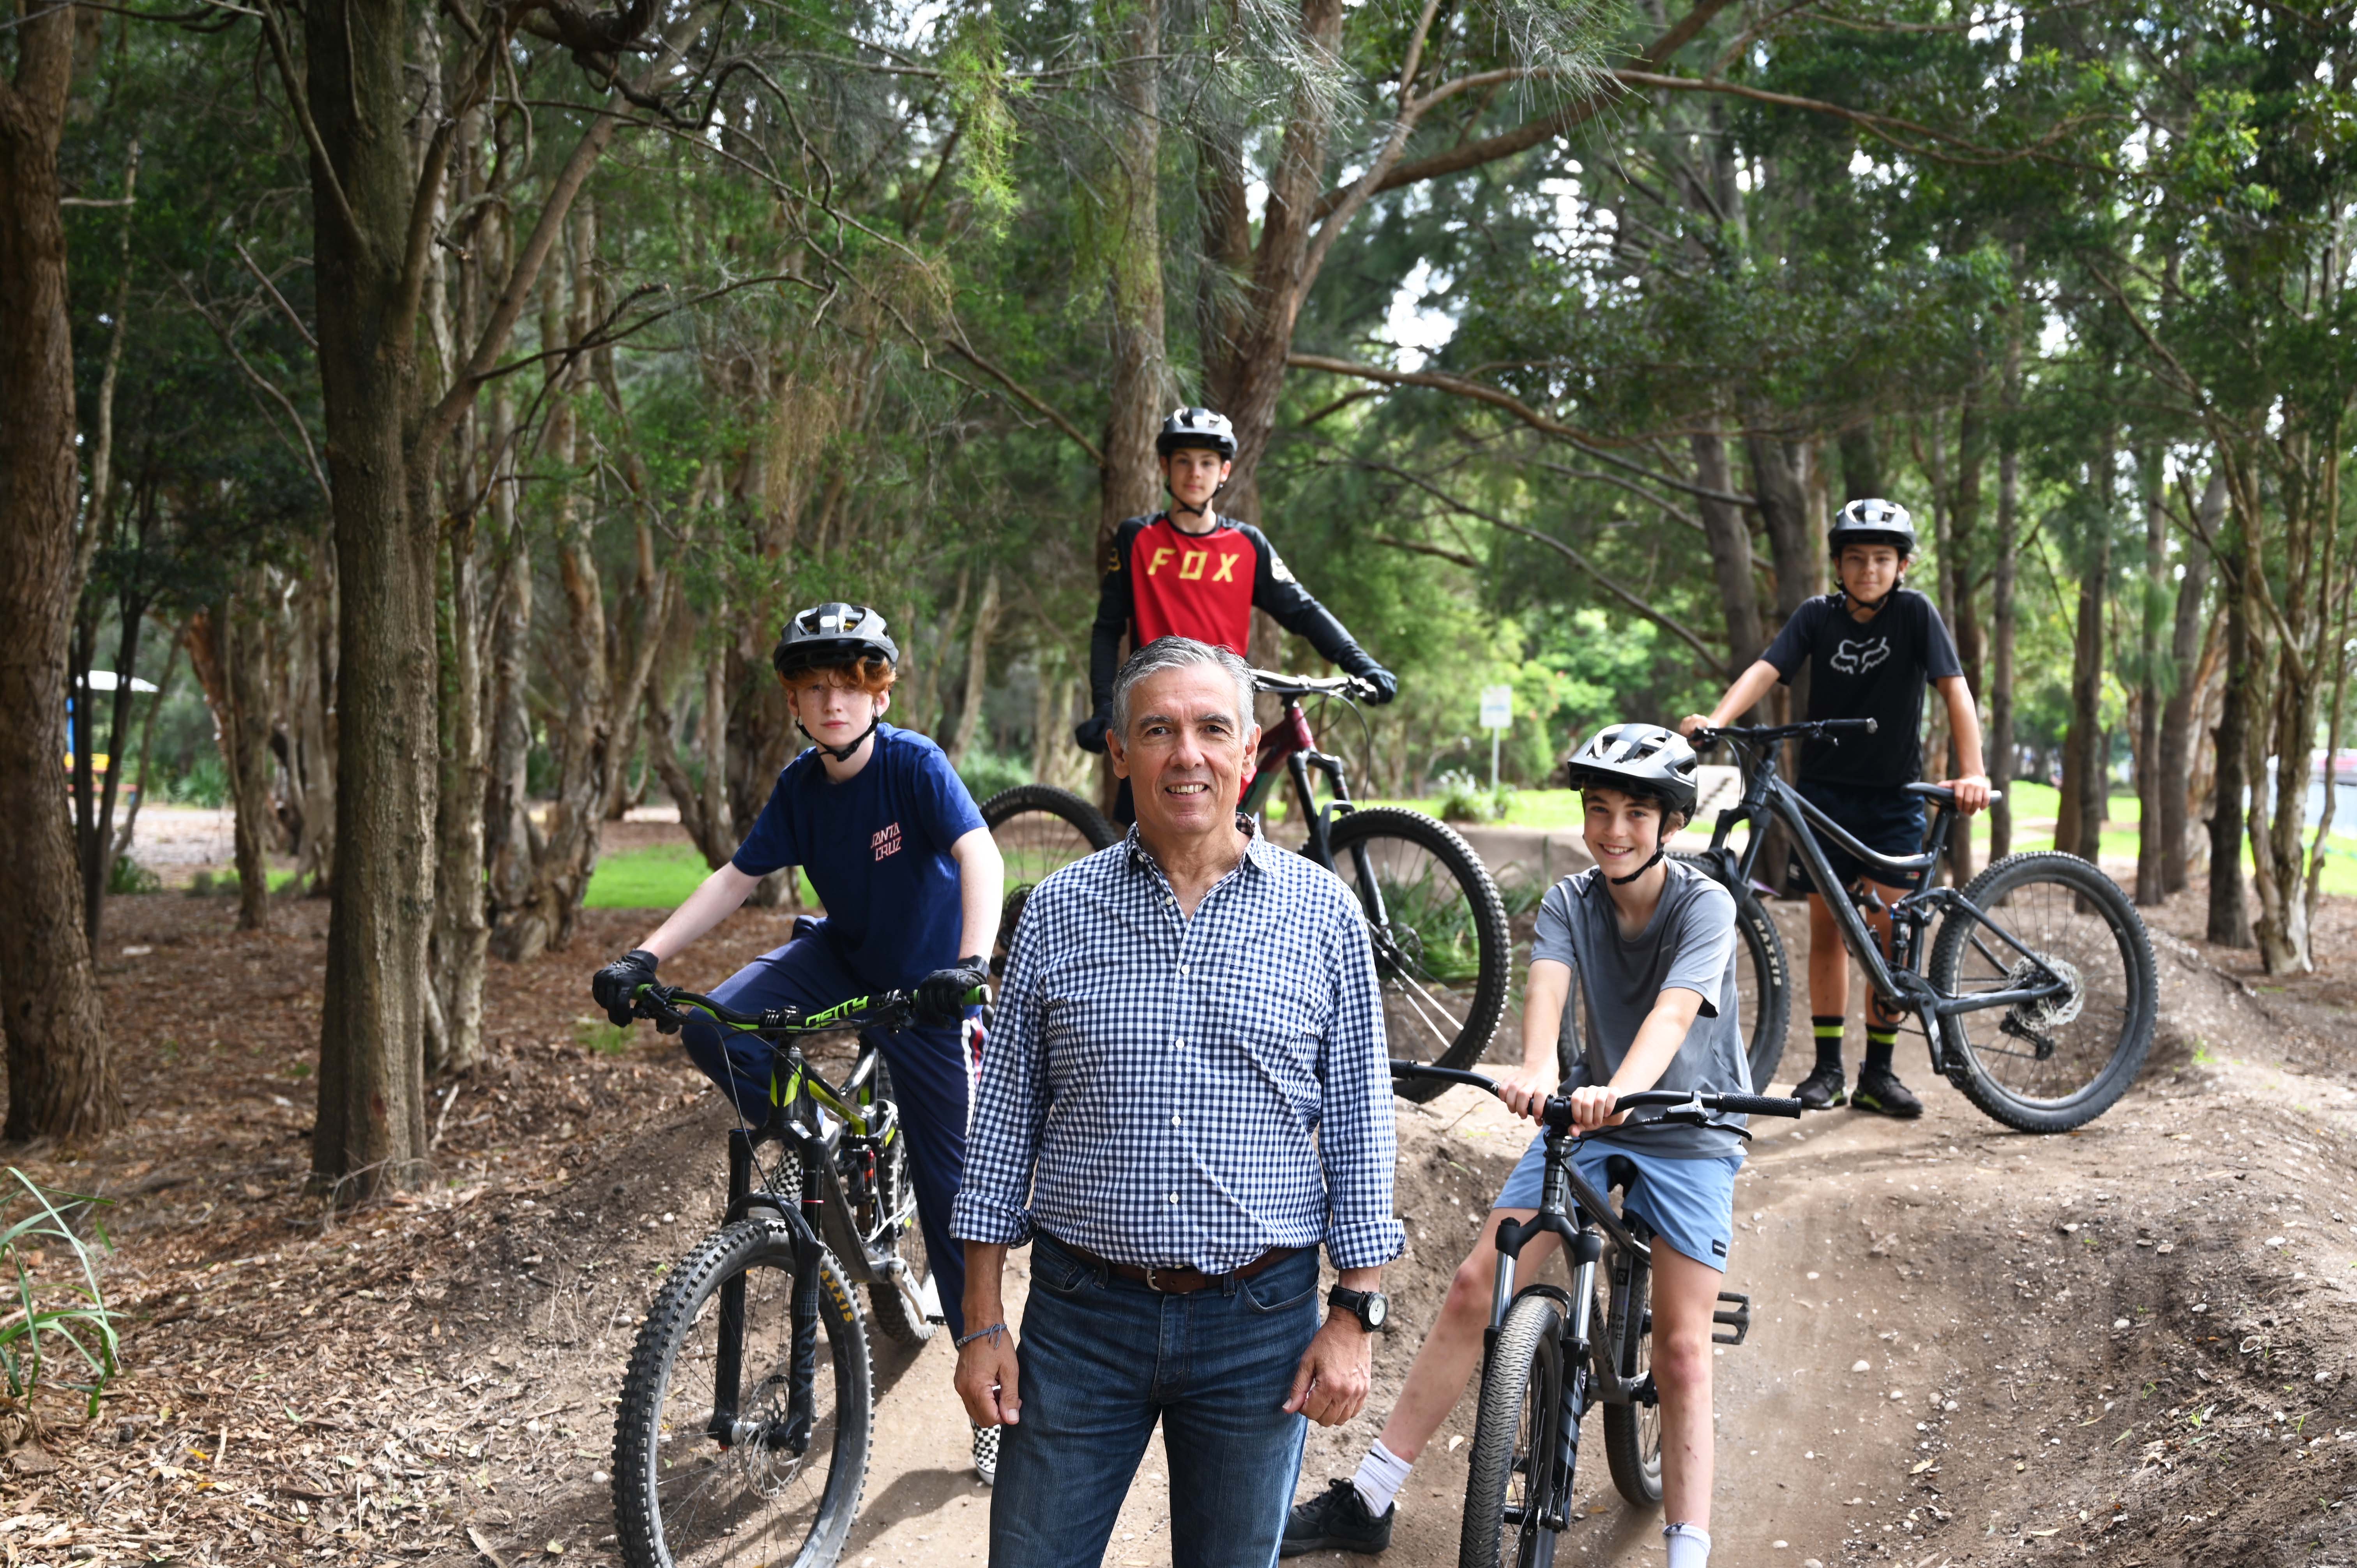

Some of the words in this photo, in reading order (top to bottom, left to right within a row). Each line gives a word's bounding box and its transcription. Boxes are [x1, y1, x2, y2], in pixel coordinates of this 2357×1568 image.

[1147, 547, 1240, 583] FOX
[870, 822, 901, 849] SANTA
[875, 836, 902, 862] CRUZ
[1753, 918, 1782, 986] MAXXIS
[806, 996, 869, 1029] DEITY
[820, 1263, 854, 1323] AXXIS
[794, 1319, 818, 1397] YARI
